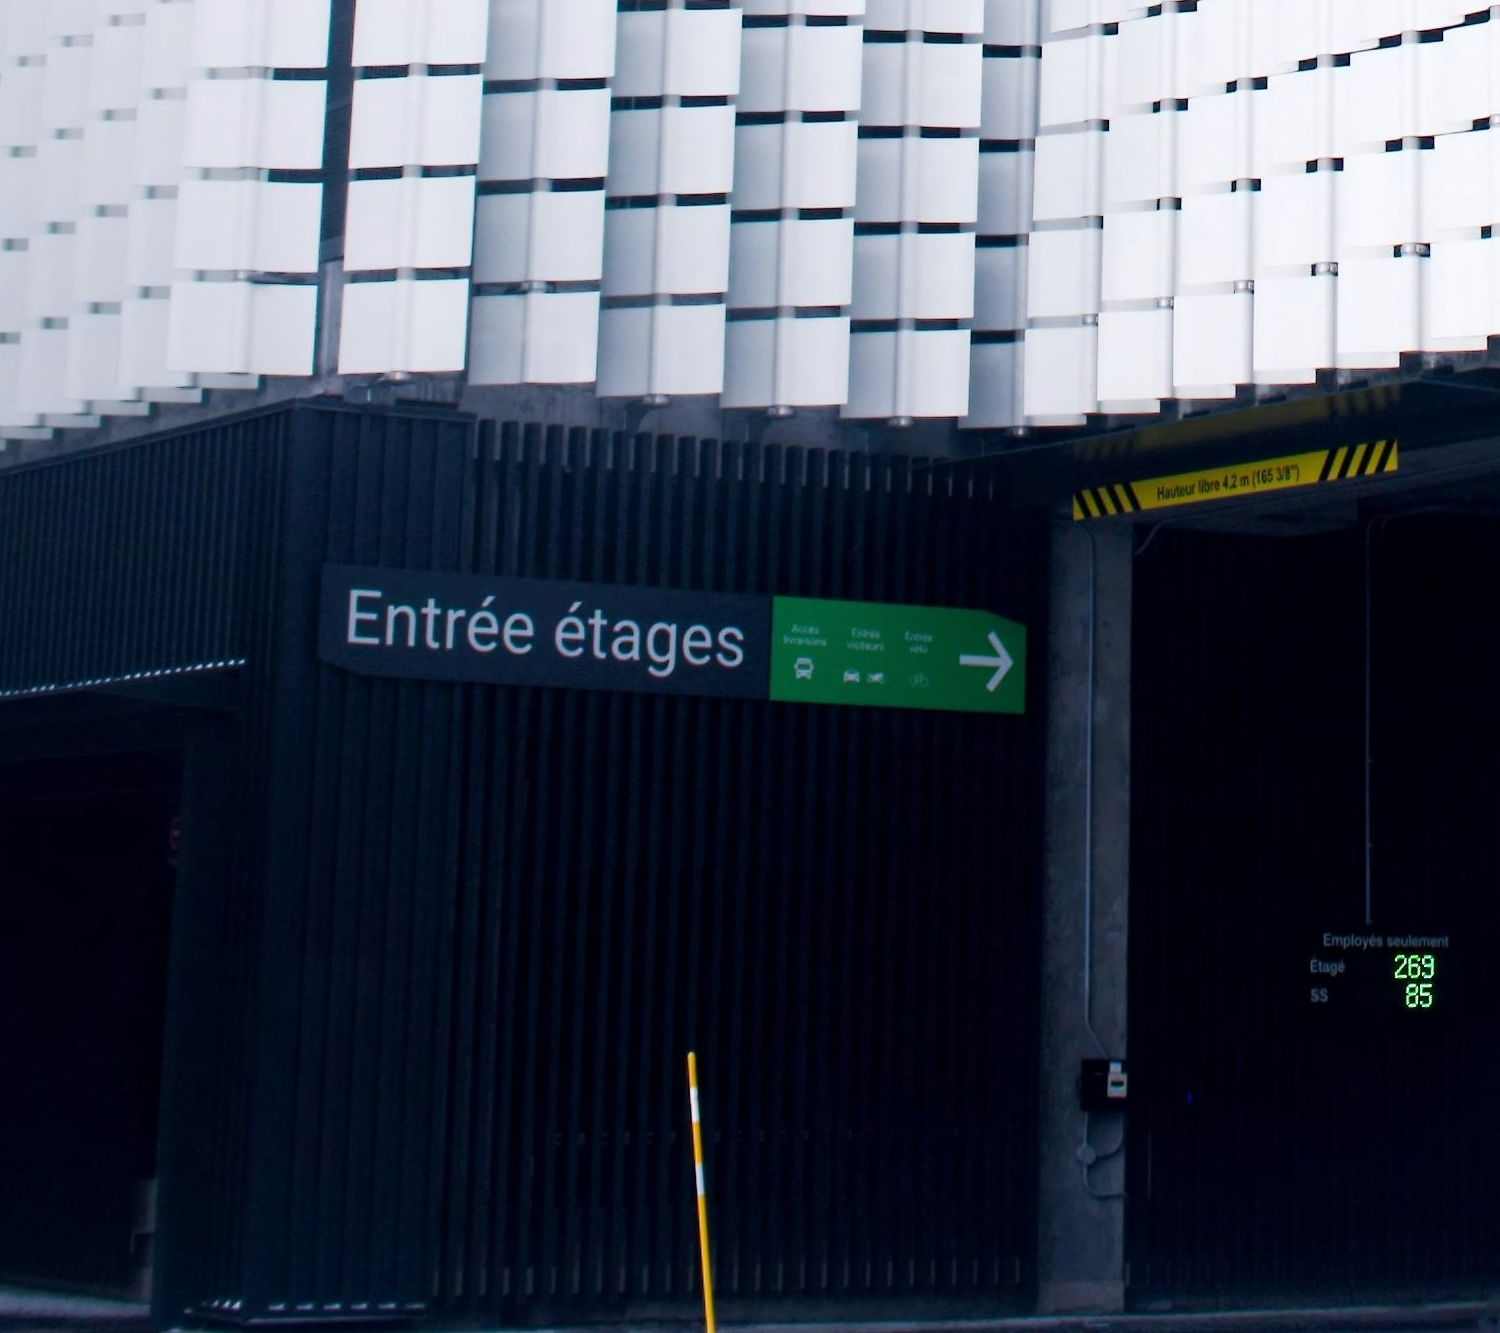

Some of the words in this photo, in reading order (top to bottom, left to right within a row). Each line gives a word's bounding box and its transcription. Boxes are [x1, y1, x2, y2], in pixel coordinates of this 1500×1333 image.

[1157, 483, 1195, 501] Hauteur
[1198, 478, 1220, 494] libre
[1223, 473, 1237, 490] 4,2
[1240, 474, 1250, 487] m
[1252, 467, 1273, 488] (165
[346, 588, 534, 655] Entrée
[554, 600, 744, 678] étages
[1323, 933, 1384, 950] Employés
[1386, 934, 1450, 949] seulement
[1393, 953, 1436, 979] 269
[1310, 987, 1329, 1003] SS
[1405, 983, 1434, 1009] 85
